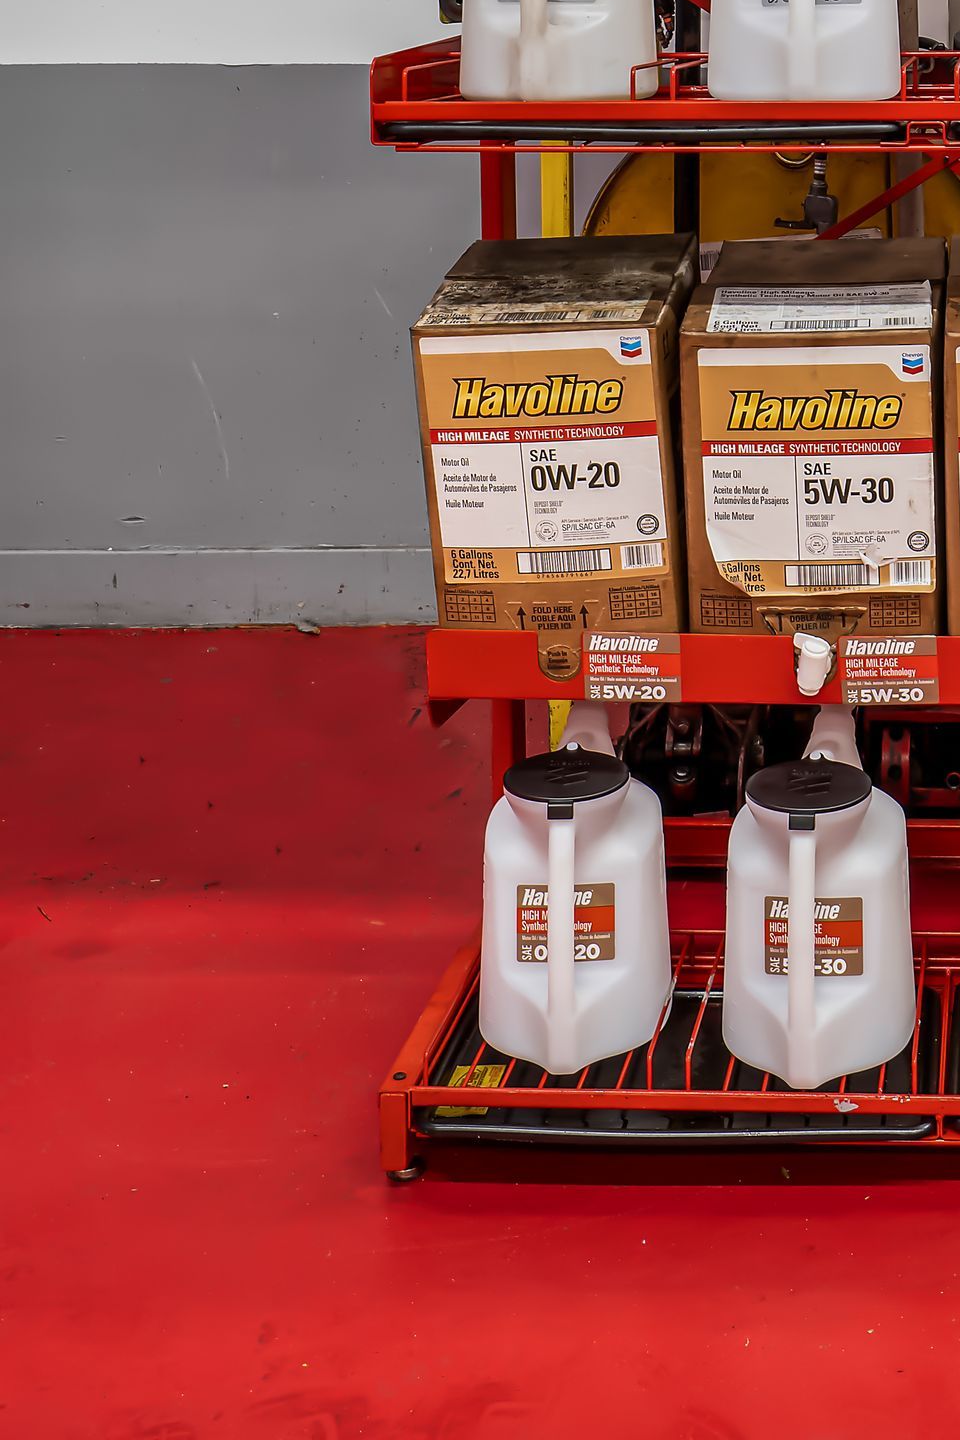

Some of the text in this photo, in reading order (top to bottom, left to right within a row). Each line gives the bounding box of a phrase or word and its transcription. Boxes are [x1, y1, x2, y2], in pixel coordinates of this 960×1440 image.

[452, 374, 625, 419] Havoline
[726, 389, 902, 431] Havoline
[437, 425, 625, 442] HIGH MILEAGE SYNTHETIC TECHNOLOGY
[529, 448, 557, 462] SAE
[710, 442, 901, 453] HIGH MILEAGE SYNTHETIC TECHNOLOGY
[530, 462, 620, 492] 0W-20
[803, 462, 832, 476] SAE
[803, 477, 895, 505] 5W-30
[589, 635, 659, 652] Havoline
[846, 639, 916, 655] Havoline
[589, 654, 642, 665] HIGH MILEAGE
[846, 658, 898, 668] HIGH MILEAGE
[589, 664, 659, 675] Synthetic Technology
[846, 667, 916, 678] Synthetic Technology
[590, 684, 666, 700] SAE 5W-20
[848, 688, 924, 704] SAE 5W-30
[522, 910, 540, 920] HIGH
[769, 922, 787, 933] HIGH
[521, 944, 533, 961] SAE
[770, 957, 781, 973] SAE
